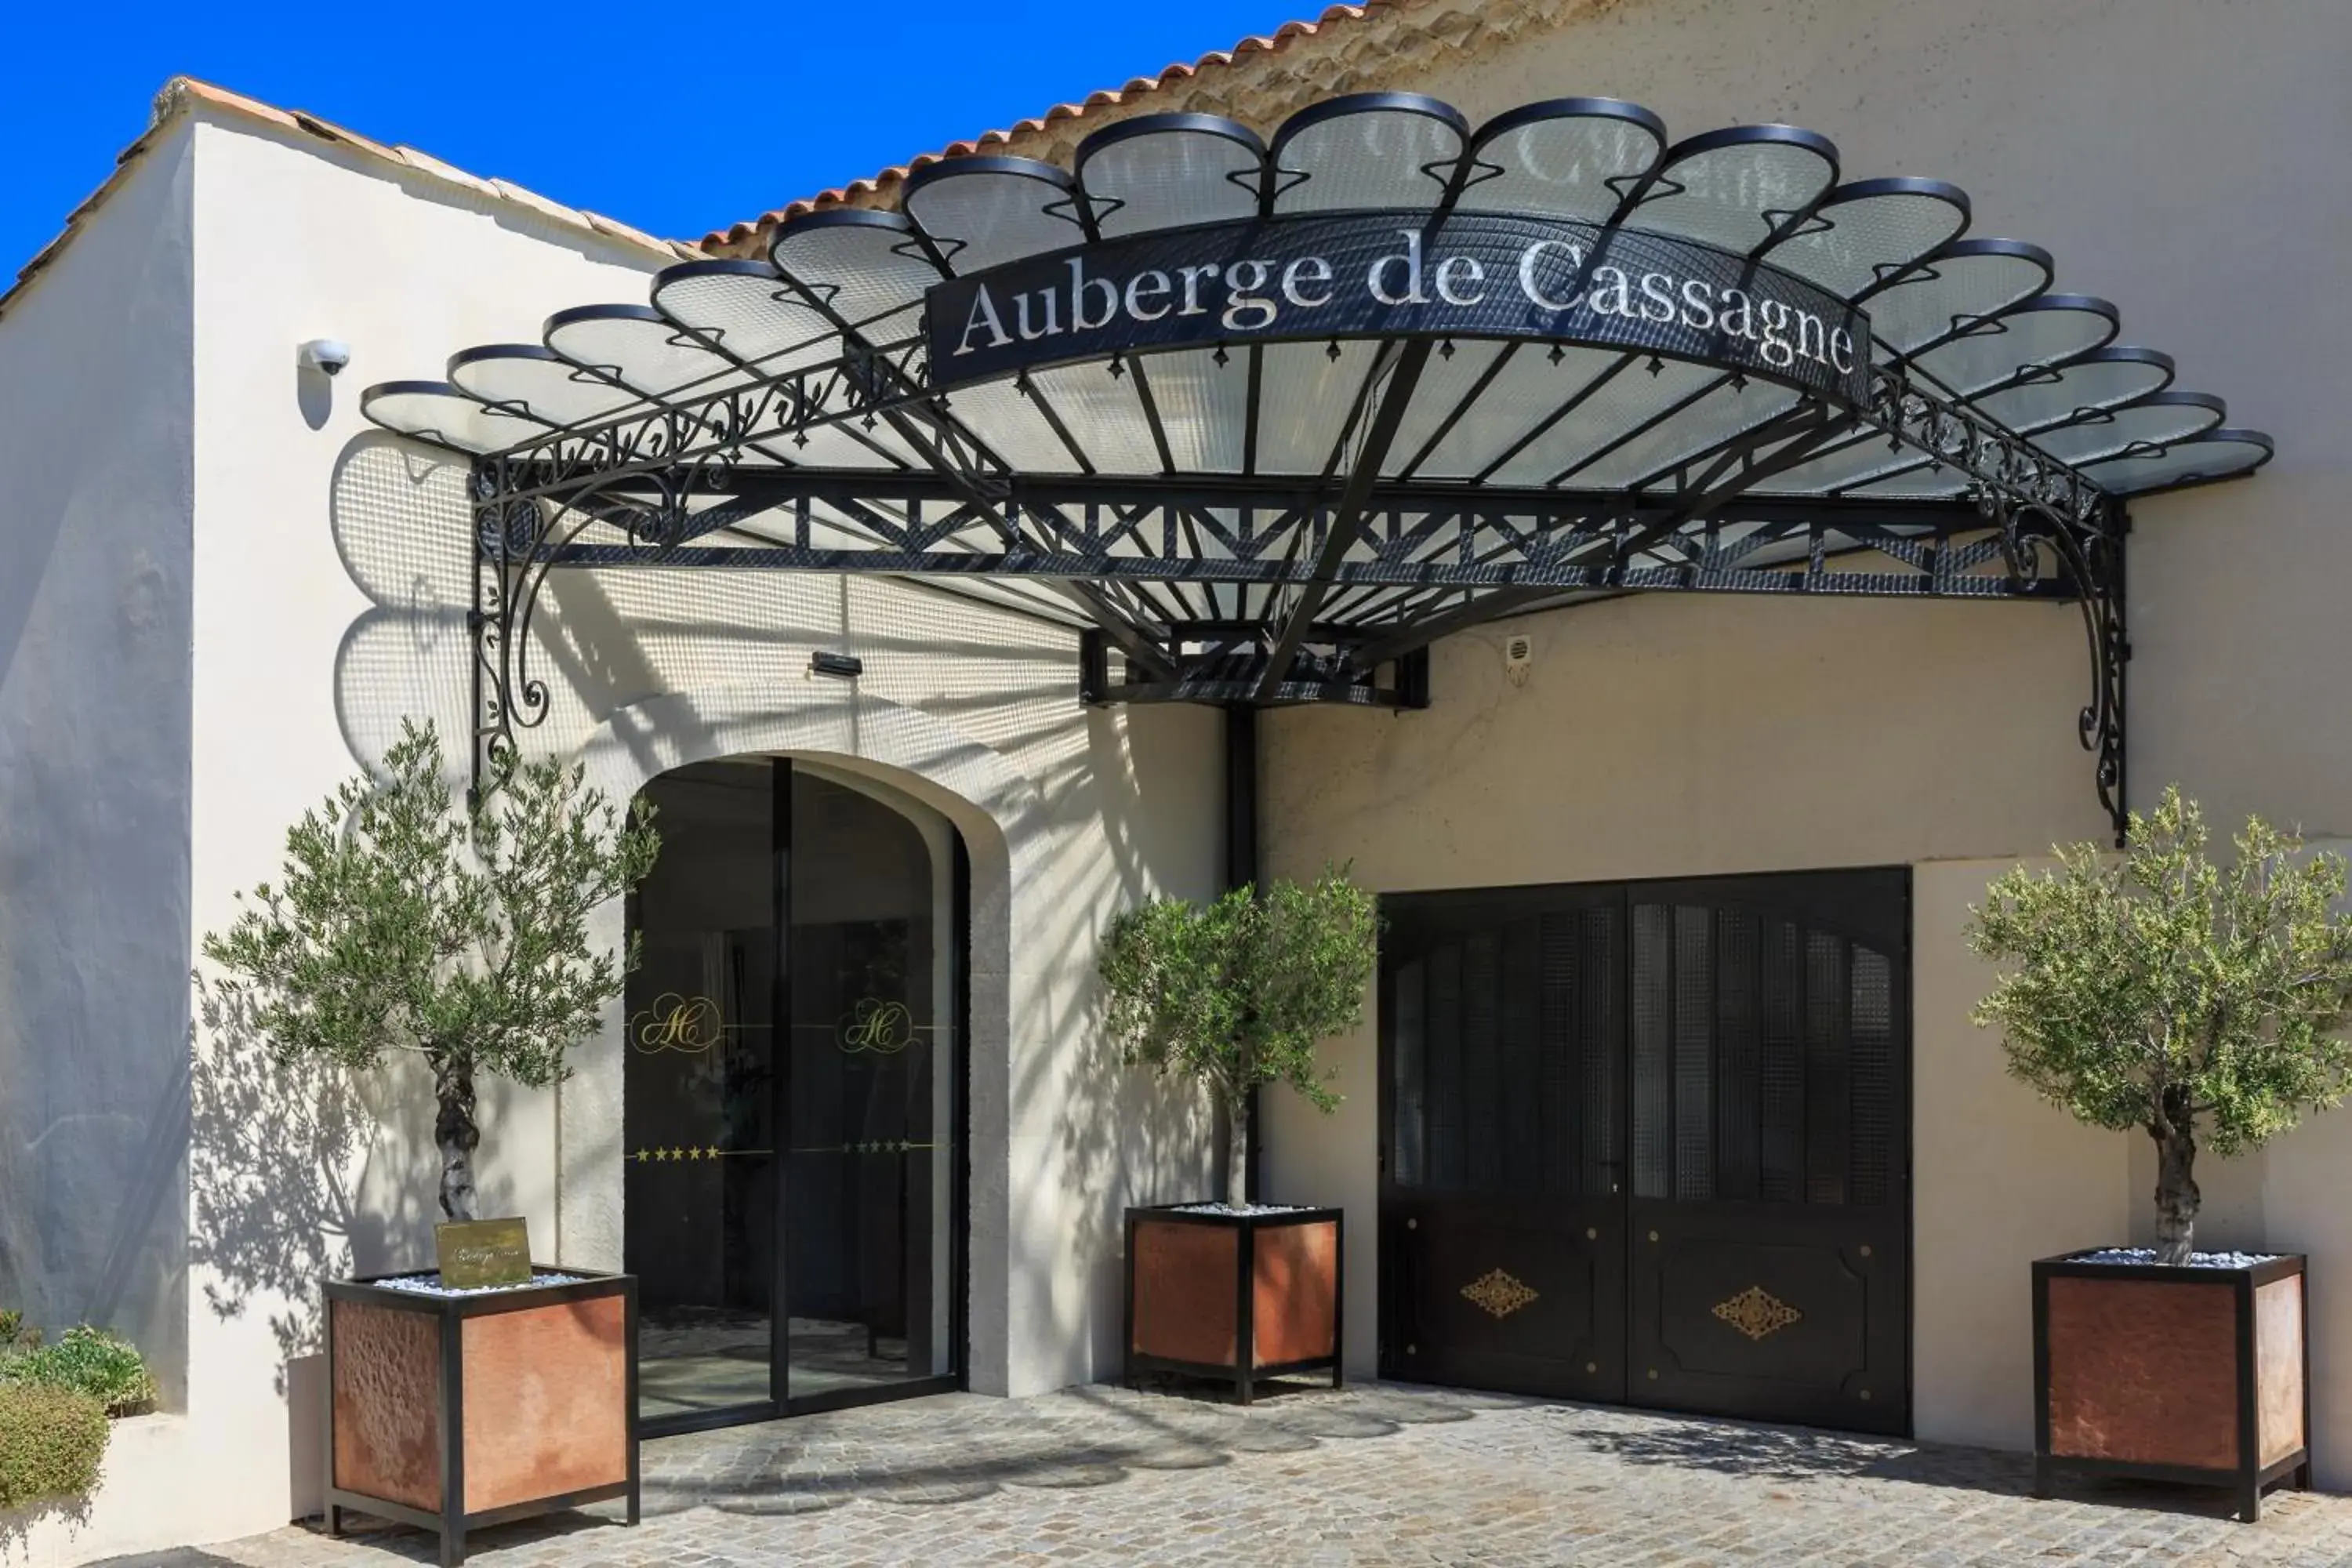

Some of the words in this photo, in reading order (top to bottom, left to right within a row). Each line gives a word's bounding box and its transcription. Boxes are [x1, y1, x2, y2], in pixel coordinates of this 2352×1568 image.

[953, 256, 1334, 356] Auberge
[1367, 229, 1487, 307] de
[1518, 239, 1854, 374] Cassagne
